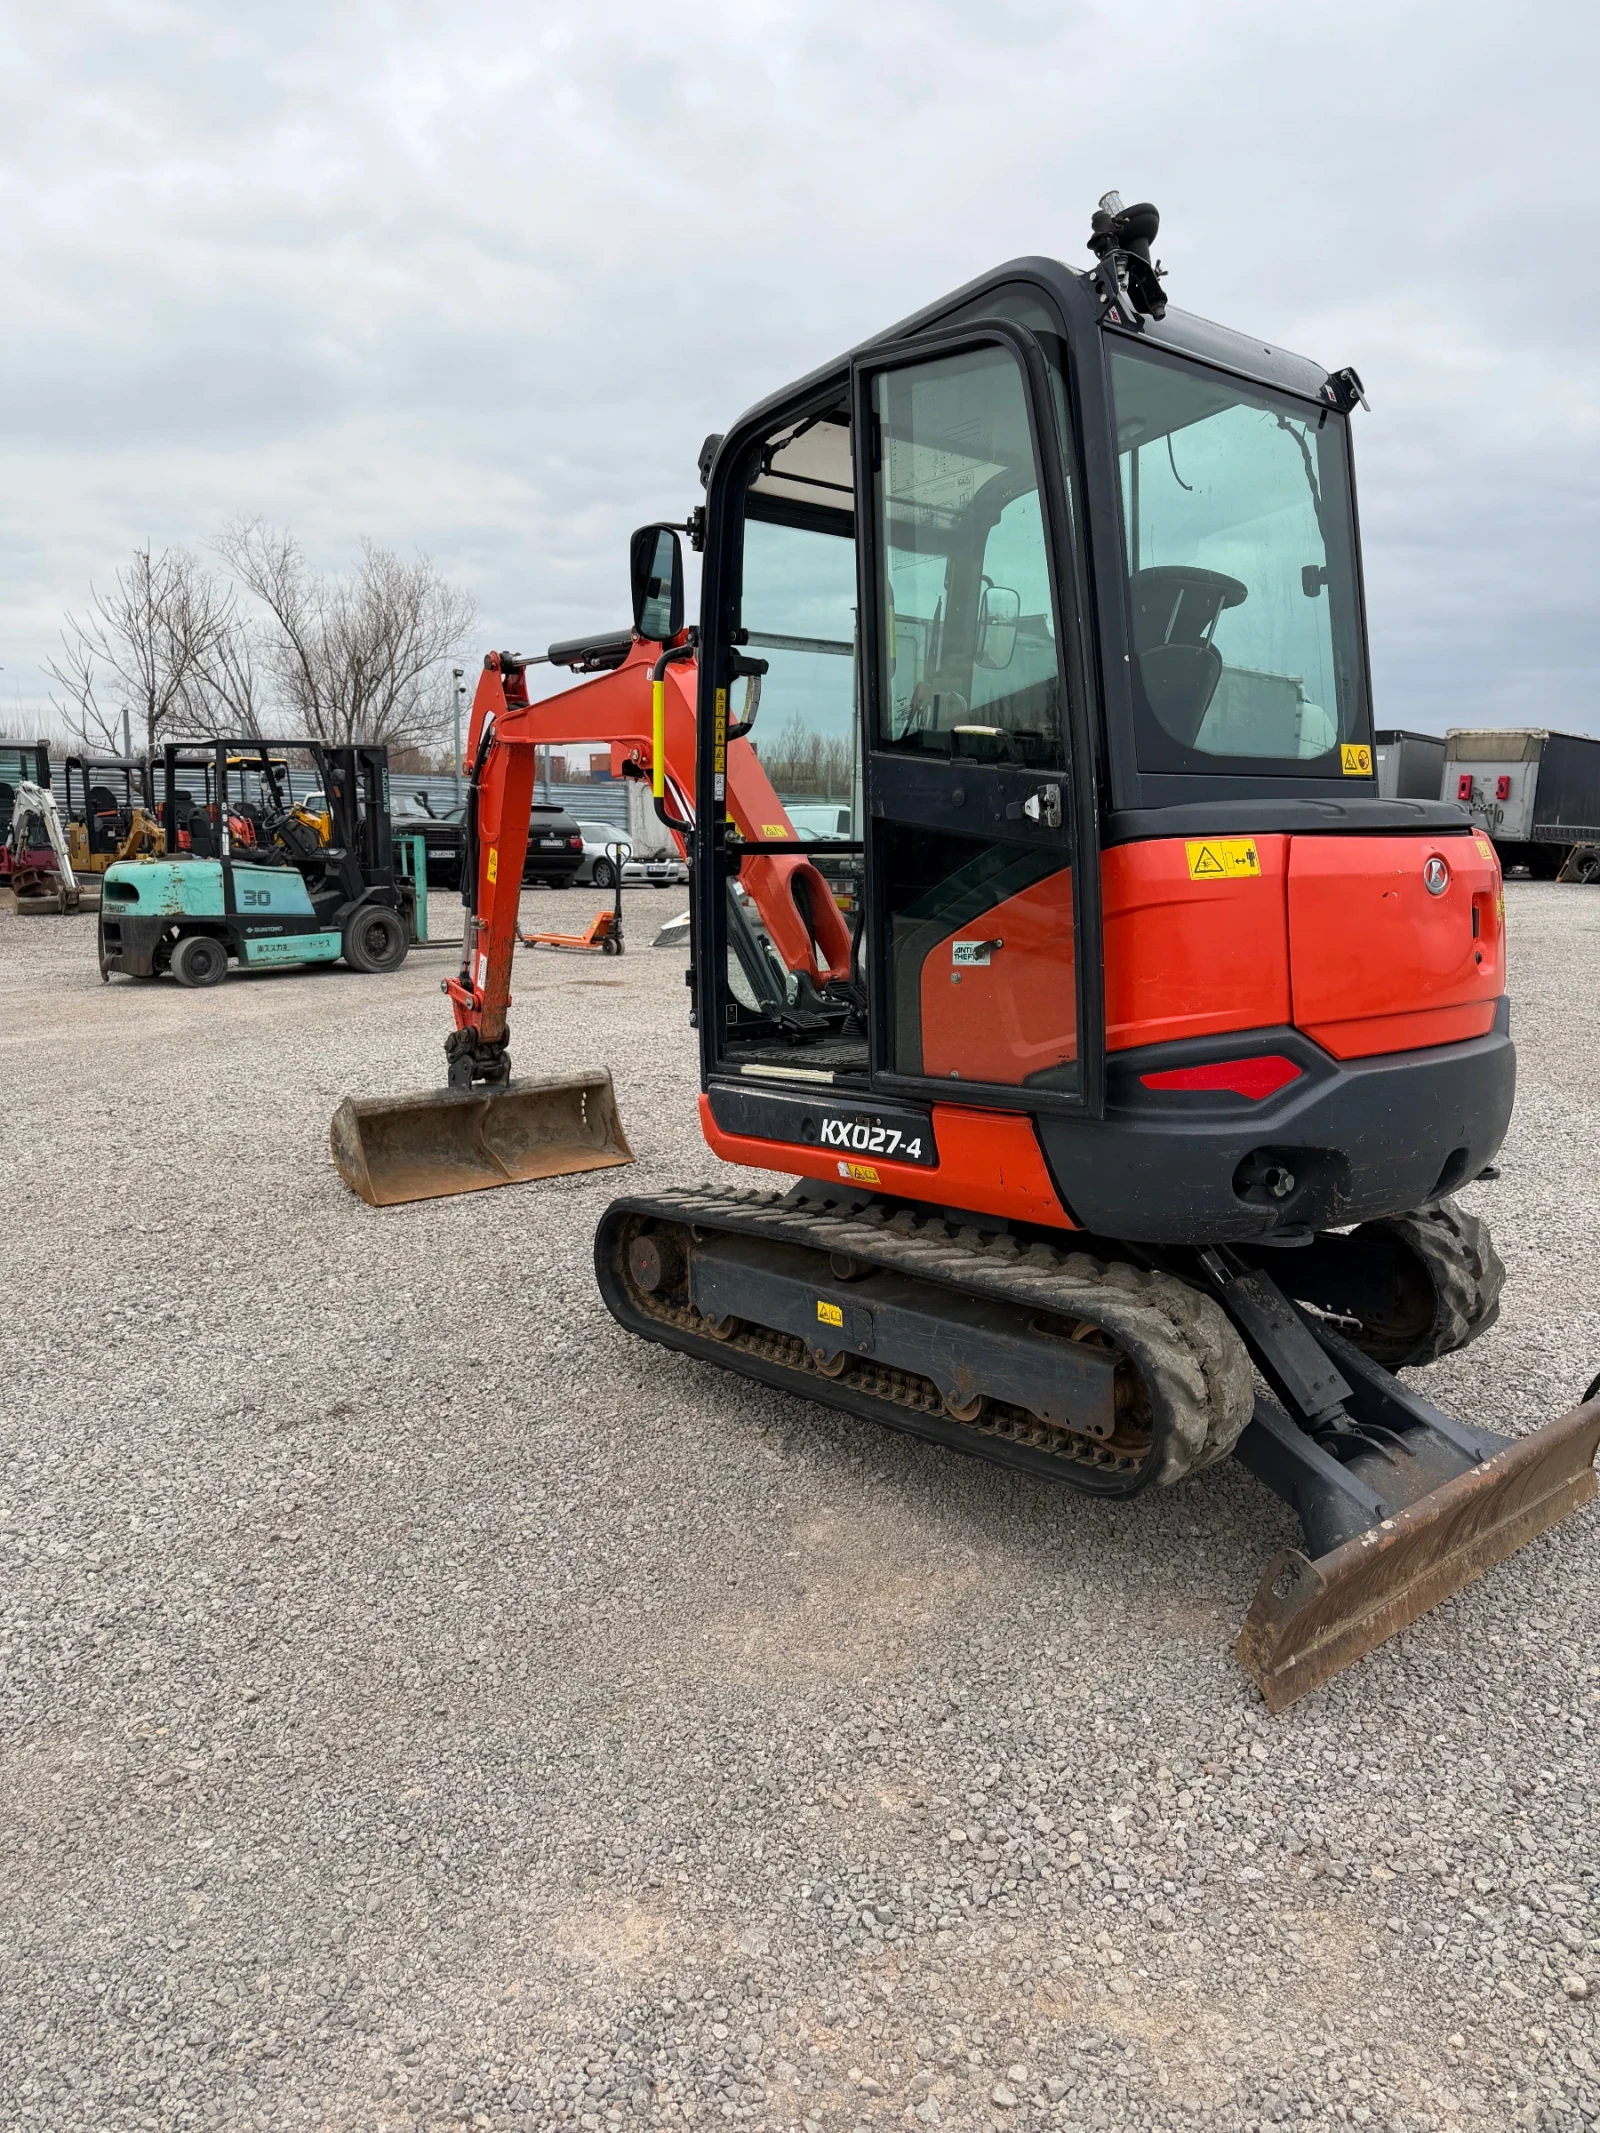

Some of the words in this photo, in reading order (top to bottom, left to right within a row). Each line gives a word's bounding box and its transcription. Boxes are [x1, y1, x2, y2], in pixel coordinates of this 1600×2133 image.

[382, 767, 390, 813] SUMITOMO
[243, 890, 271, 906] 30
[820, 1118, 922, 1159] KX027-4
